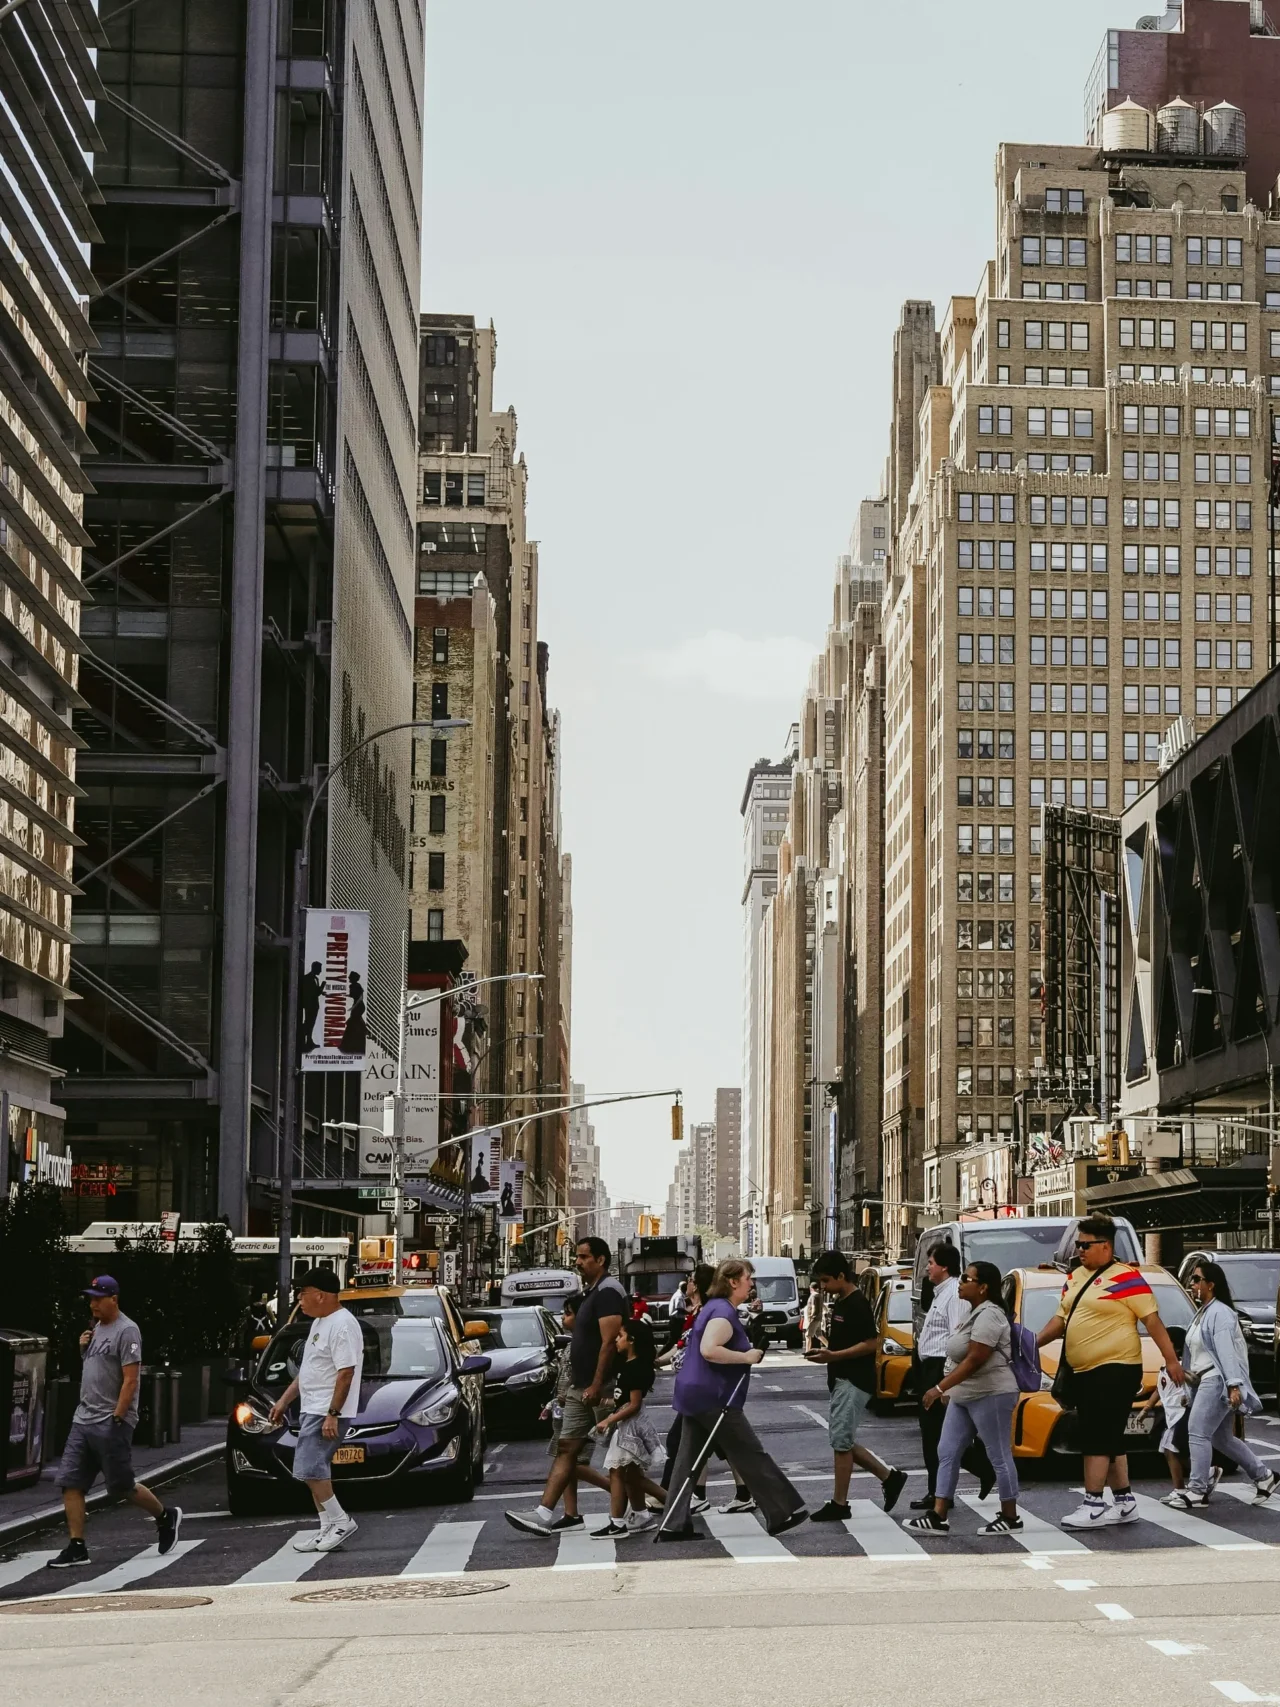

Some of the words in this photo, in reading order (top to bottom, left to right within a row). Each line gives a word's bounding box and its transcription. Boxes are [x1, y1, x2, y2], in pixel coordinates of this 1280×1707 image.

[325, 932, 348, 983] PRETTY
[323, 992, 347, 1047] WOMAN
[368, 1051, 379, 1059] At
[372, 1136, 389, 1144] Stop
[38, 1141, 72, 1188] Microsoft
[234, 1242, 260, 1250] Electric
[262, 1242, 276, 1250] Bus
